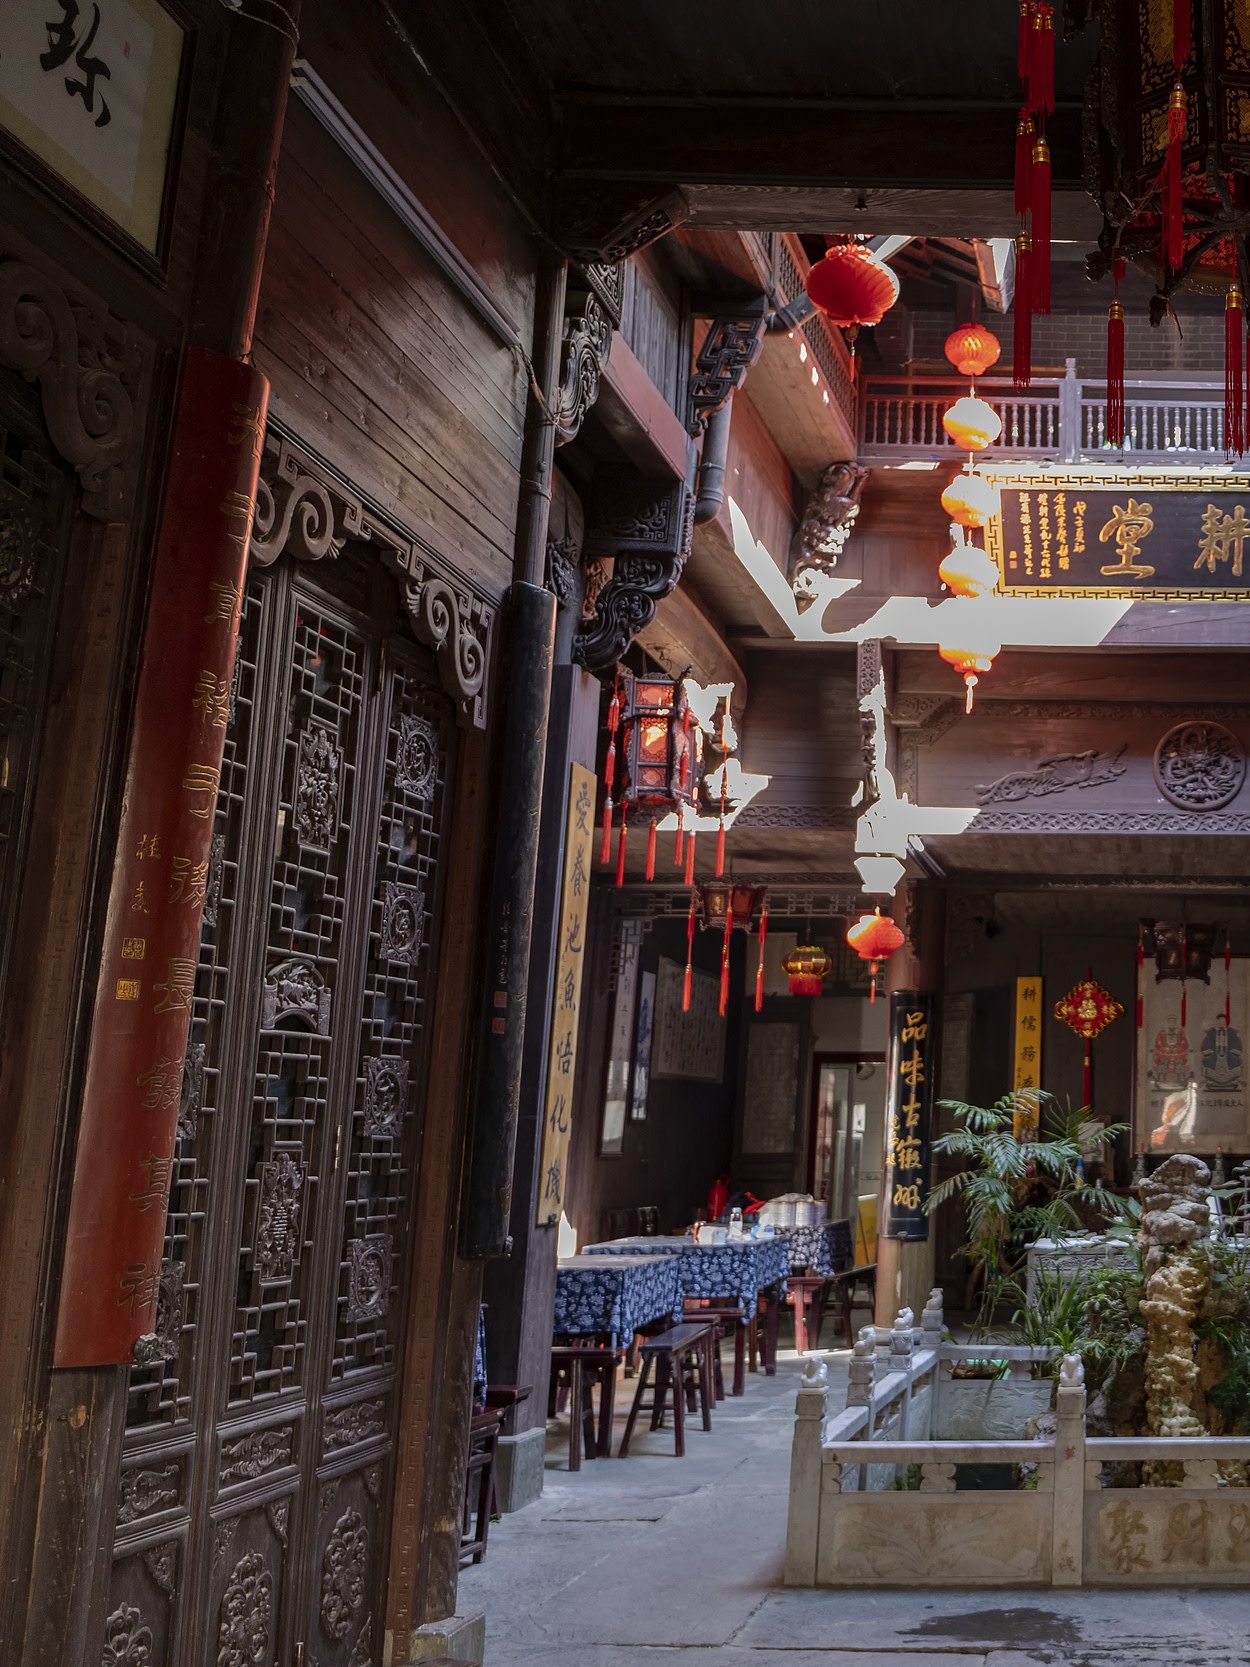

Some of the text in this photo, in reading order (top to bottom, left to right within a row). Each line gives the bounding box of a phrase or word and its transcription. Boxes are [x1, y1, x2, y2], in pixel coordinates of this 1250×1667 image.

[544, 782, 591, 1205] 愛養池魚悟化機
[893, 1011, 928, 1211] 品味古徽州
